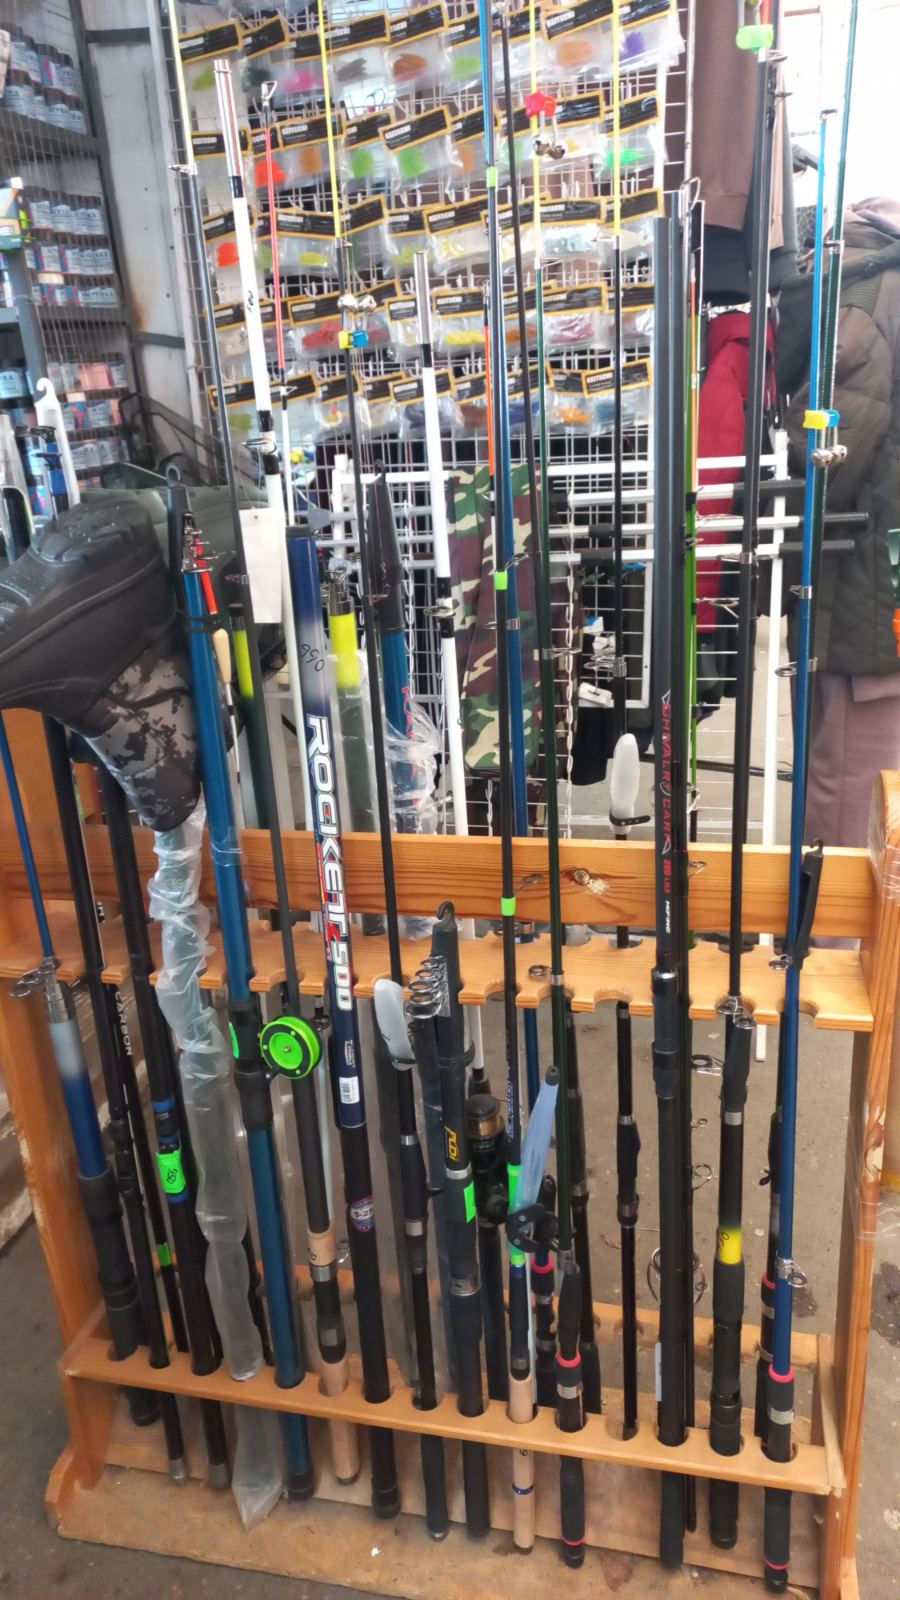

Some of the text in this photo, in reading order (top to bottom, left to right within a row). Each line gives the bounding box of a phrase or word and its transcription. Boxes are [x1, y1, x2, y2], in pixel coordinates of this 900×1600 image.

[300, 643, 325, 673] 990
[306, 713, 354, 1012] ROCKET 500
[114, 991, 133, 1057] CARBON
